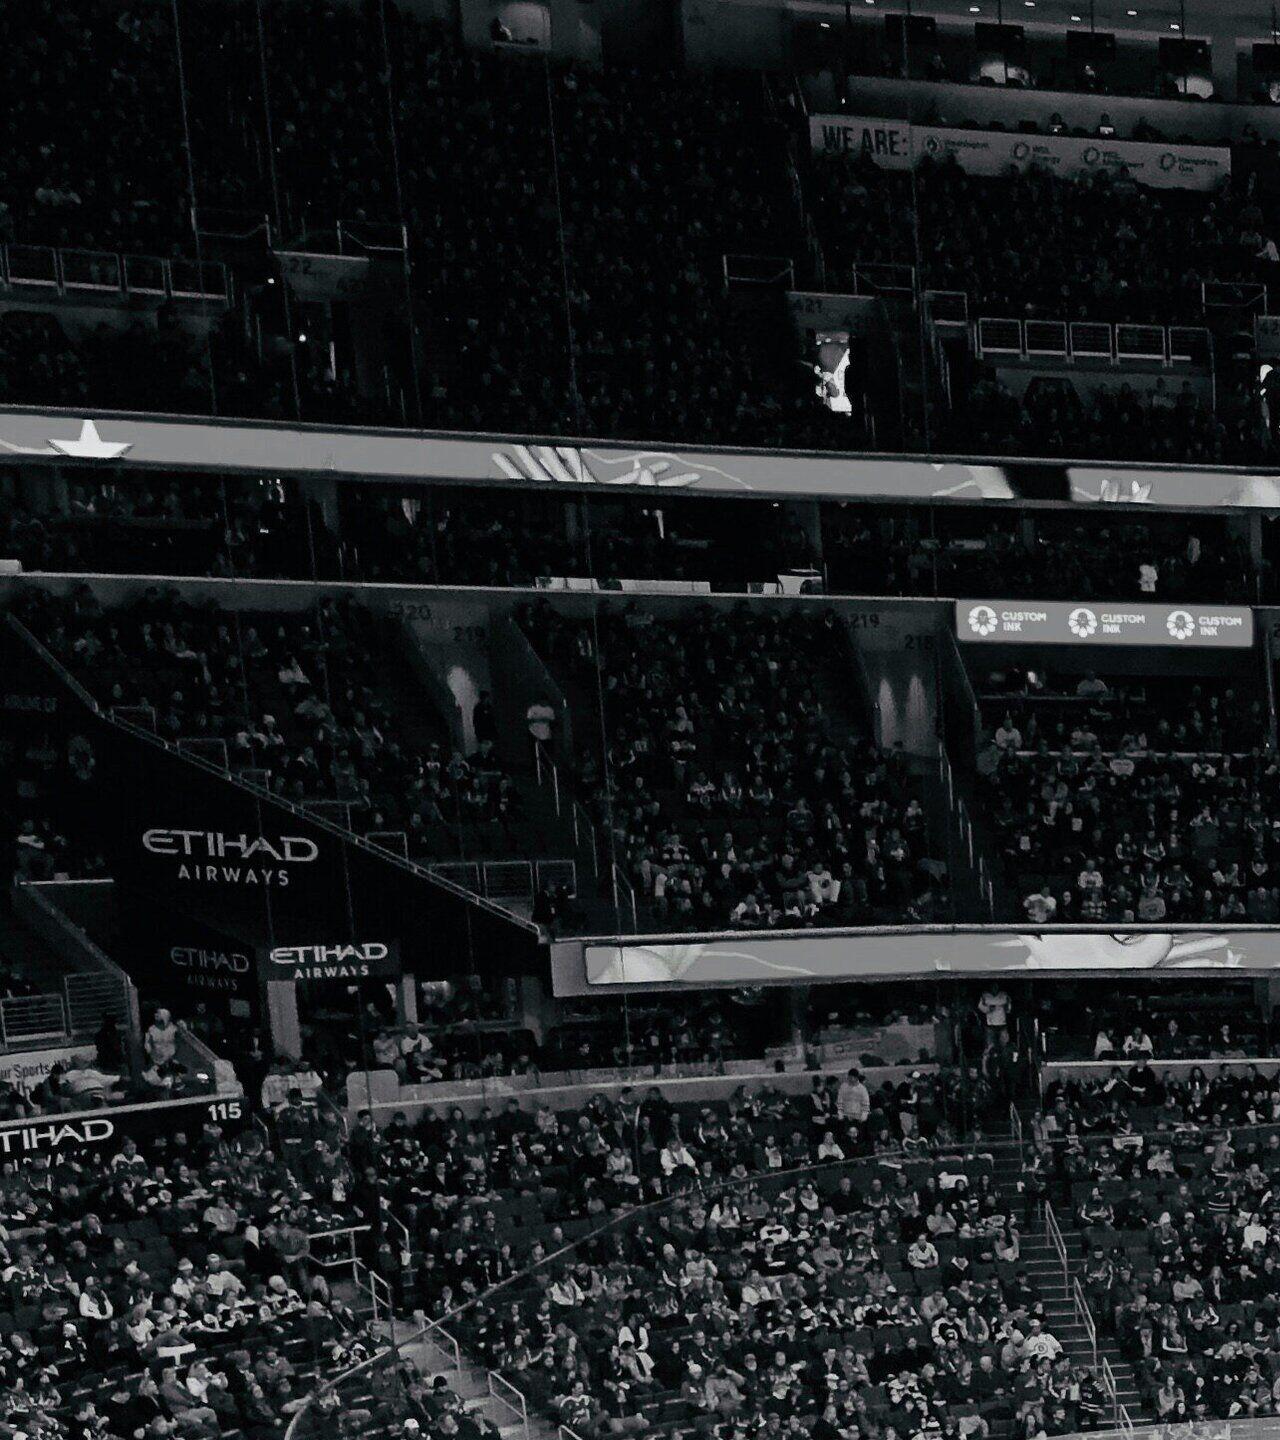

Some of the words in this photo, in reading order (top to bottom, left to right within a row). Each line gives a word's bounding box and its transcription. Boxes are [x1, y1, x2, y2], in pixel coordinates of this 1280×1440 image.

[822, 125, 854, 153] WE
[1001, 611, 1047, 624] CUSTOM
[1100, 614, 1146, 626] CUSTOM
[1198, 617, 1242, 628] CUSTOM
[1001, 623, 1022, 633] INK
[1101, 625, 1121, 635] INK
[1199, 627, 1218, 636] INK
[142, 828, 319, 862] ETIHAD
[177, 862, 289, 887] AIRWAYS
[170, 945, 250, 974] ETIHAD
[269, 943, 389, 965] ETIHAD
[294, 963, 369, 978] AIRWAYS
[187, 971, 238, 992] AIRWAYS
[207, 1102, 242, 1121] 115
